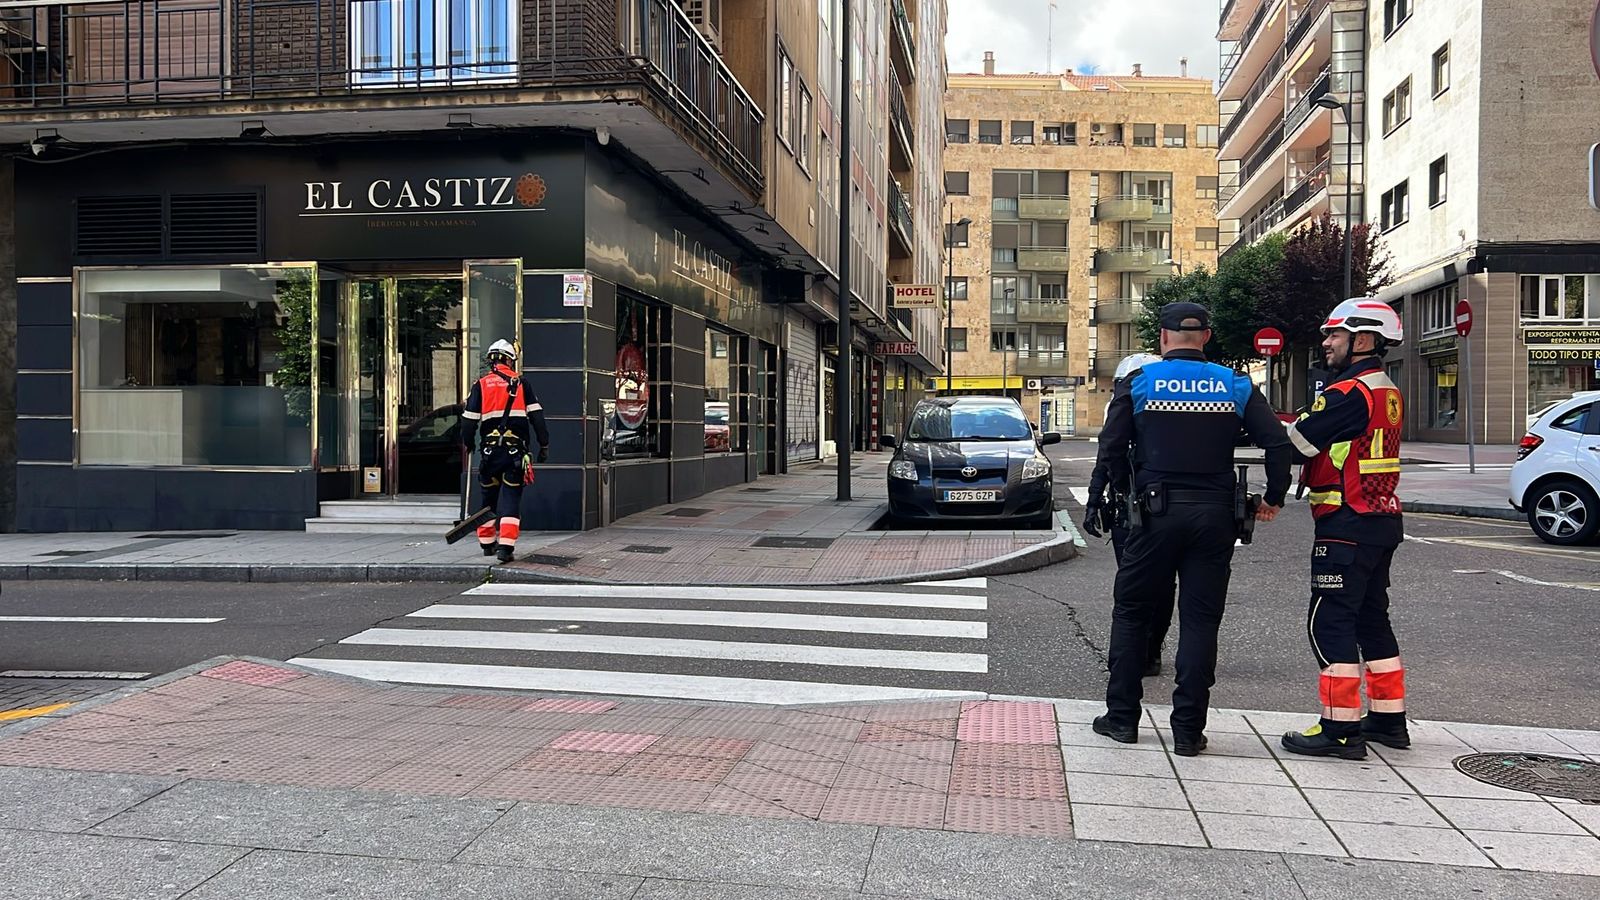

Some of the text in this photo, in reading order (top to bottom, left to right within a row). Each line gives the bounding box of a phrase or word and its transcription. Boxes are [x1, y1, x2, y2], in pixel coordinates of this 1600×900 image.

[304, 181, 352, 210] EL
[674, 229, 689, 270] EL
[897, 288, 935, 296] HOTEL
[875, 343, 917, 354] GARAGE
[1530, 350, 1600, 359] TODO TIPO DE R
[1154, 378, 1228, 393] POLICÍA
[1315, 381, 1324, 390] P
[950, 491, 994, 501] 6275 GZP
[1314, 546, 1327, 557] 152
